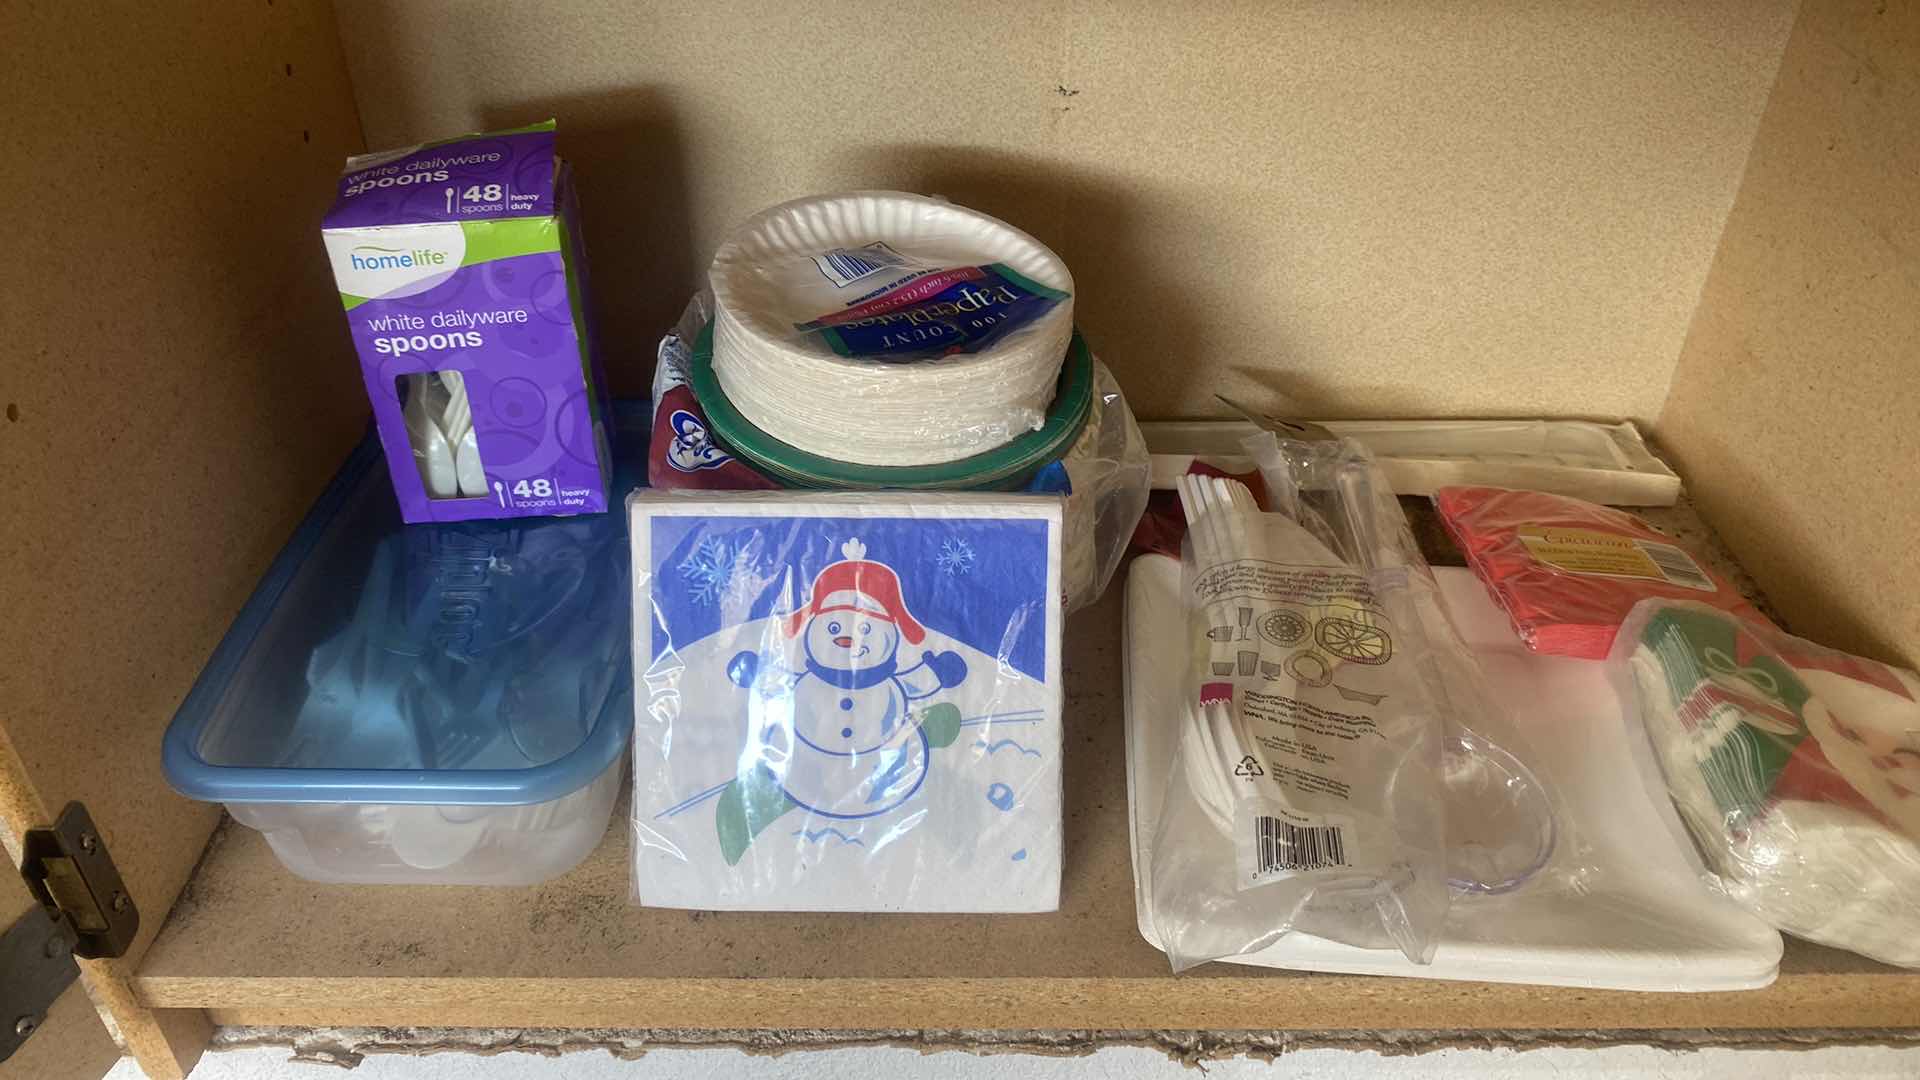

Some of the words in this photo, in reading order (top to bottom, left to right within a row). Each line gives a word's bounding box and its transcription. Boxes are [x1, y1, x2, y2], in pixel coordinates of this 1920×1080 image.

[348, 165, 400, 184] white
[405, 150, 502, 172] dailyware
[344, 169, 449, 198] spoons
[463, 184, 502, 202] 48
[511, 193, 540, 202] heavy
[462, 202, 503, 213] spoons
[511, 202, 533, 210] duty
[352, 249, 445, 270] homelife
[368, 314, 424, 332] white
[431, 309, 528, 329] dailyware
[374, 330, 483, 357] spoons
[513, 479, 552, 498] 48
[561, 489, 590, 498] heavy
[515, 498, 556, 508] spoons
[563, 497, 585, 506] duty
